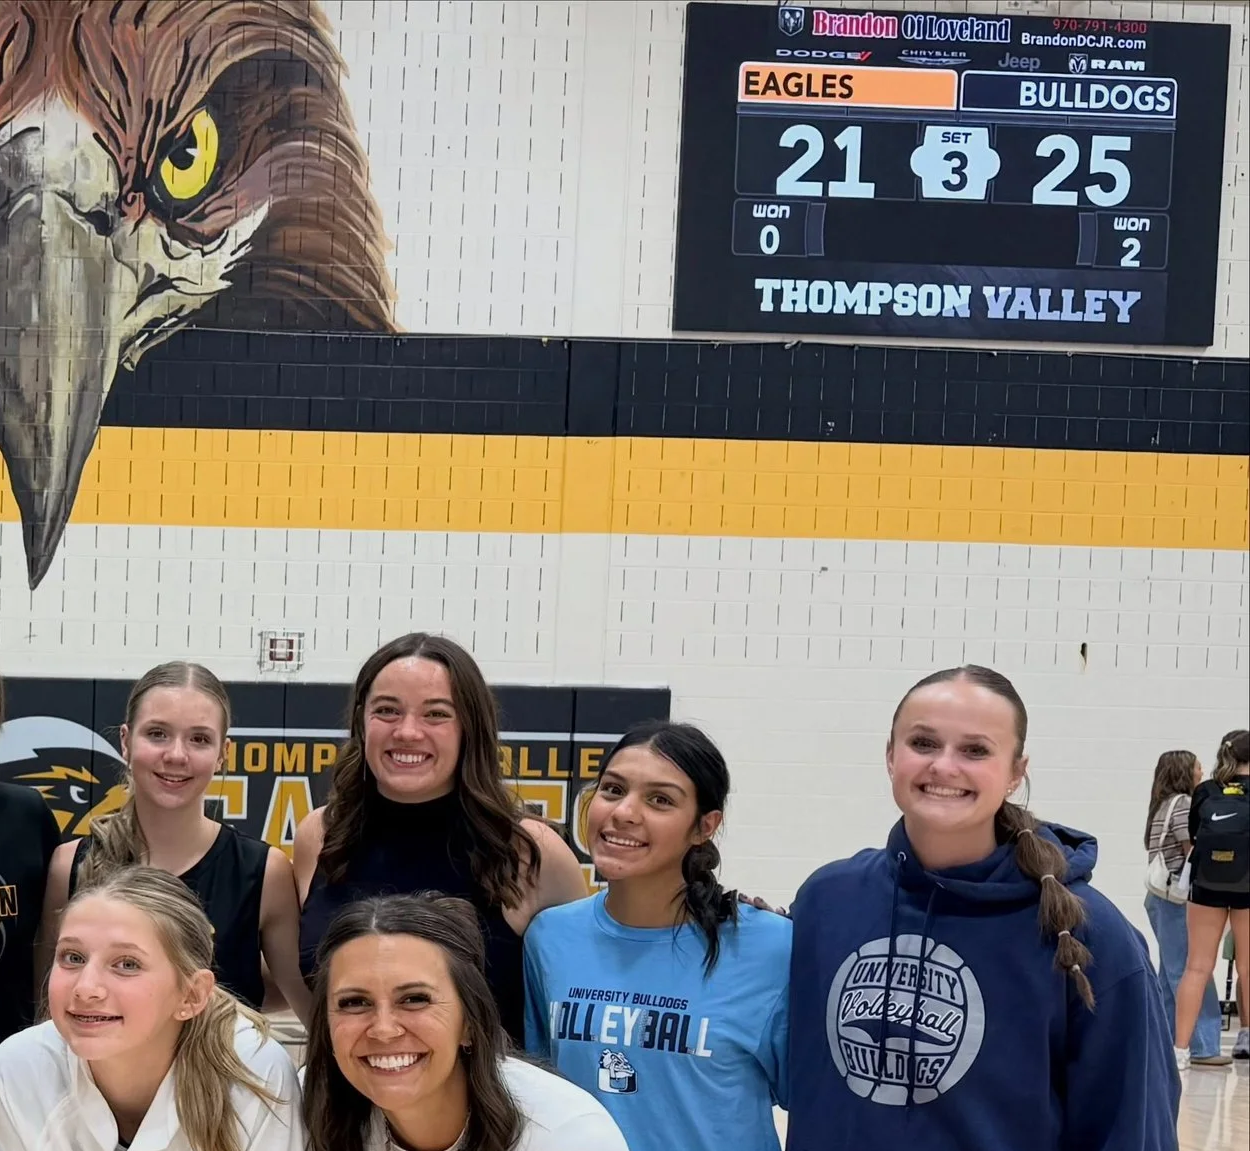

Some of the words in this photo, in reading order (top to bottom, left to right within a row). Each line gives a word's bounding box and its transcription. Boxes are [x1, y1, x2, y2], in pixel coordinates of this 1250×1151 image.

[812, 10, 898, 39] Brandon
[902, 15, 923, 40] Of
[926, 16, 1011, 43] Loveland
[1021, 33, 1146, 49] BrandonDCJR.com
[1053, 18, 1147, 34] 970-791-4300
[776, 49, 861, 60] DODGE
[998, 52, 1041, 71] Jeep
[1091, 59, 1146, 71] RAM
[745, 71, 853, 99] EAGLES
[1019, 80, 1171, 112] BULLDOGS
[941, 131, 973, 145] SET
[776, 124, 875, 198] 21
[941, 151, 969, 192] 3
[1032, 134, 1132, 207] 25
[759, 225, 780, 255] 0
[1120, 237, 1141, 268] 2
[754, 278, 972, 318] THOMPSON
[982, 286, 1141, 324] VALLEY
[568, 987, 630, 1004] UNIVERSITY
[632, 992, 689, 1011] BULLDOGS
